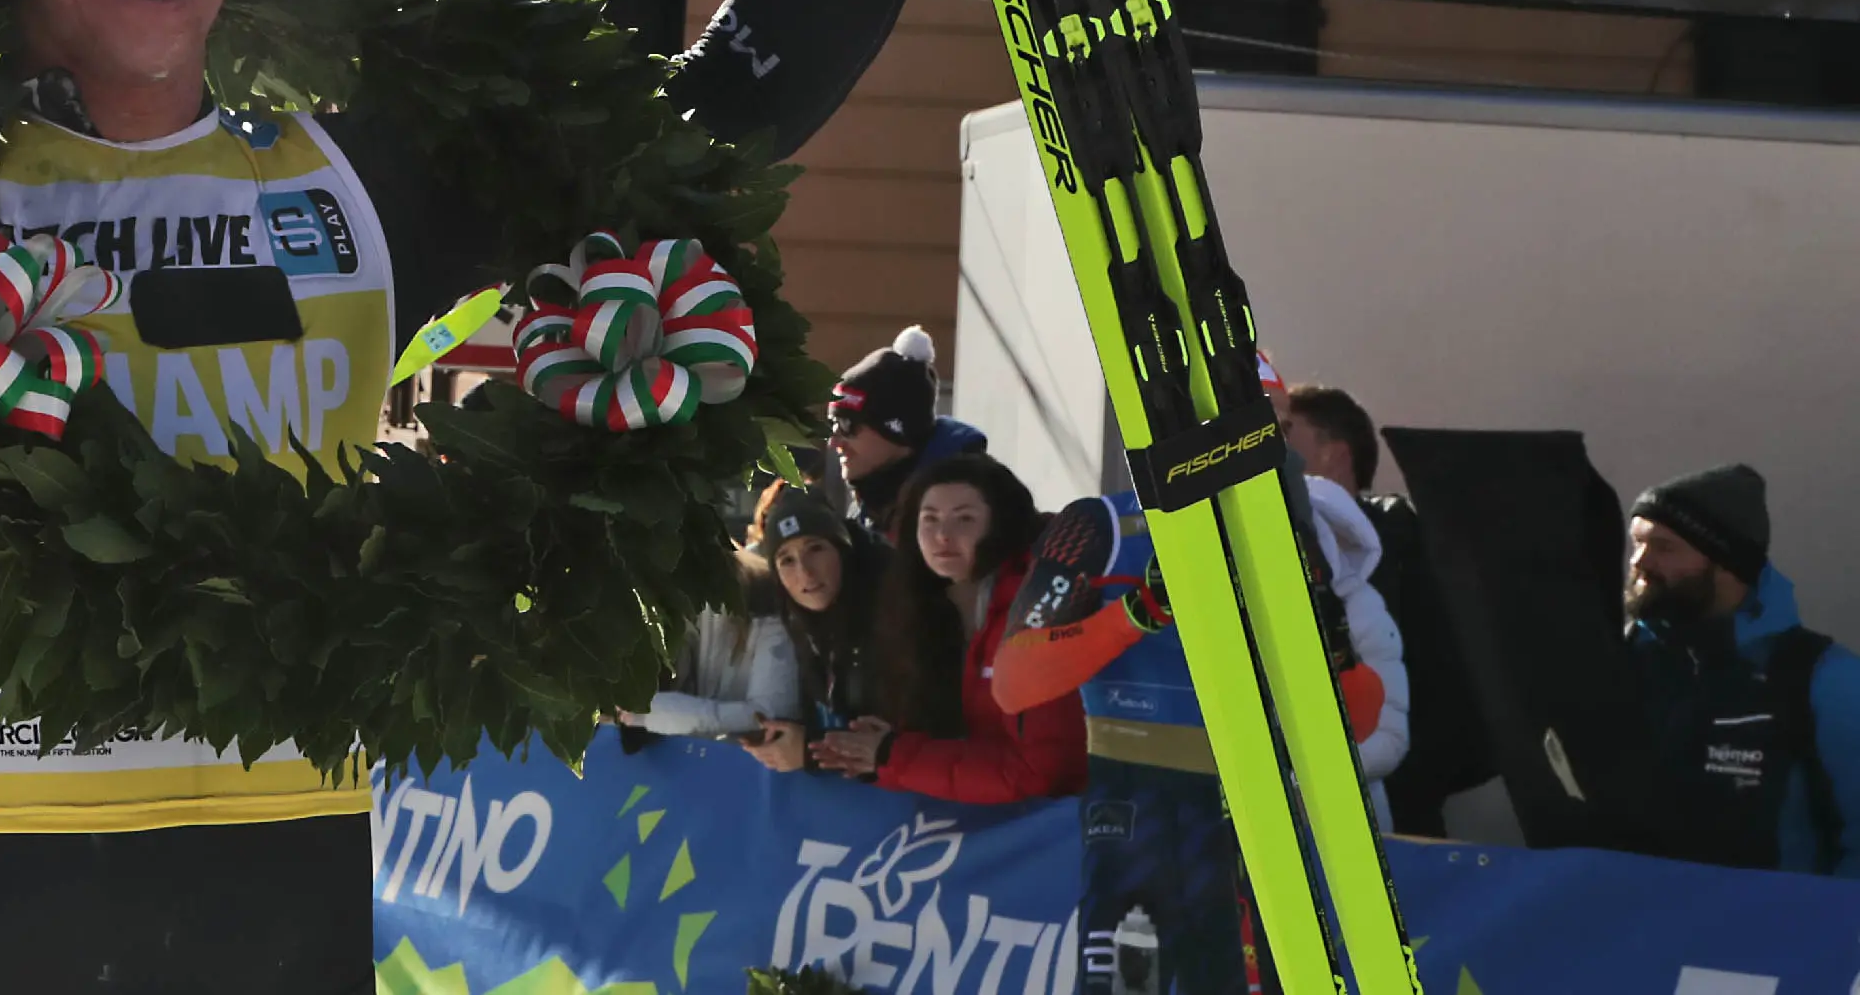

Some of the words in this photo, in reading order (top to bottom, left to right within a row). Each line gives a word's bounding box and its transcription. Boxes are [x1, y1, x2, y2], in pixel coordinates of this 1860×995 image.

[151, 214, 257, 268] LIVE
[319, 203, 351, 255] PLAY
[1166, 422, 1276, 484] FISCHER
